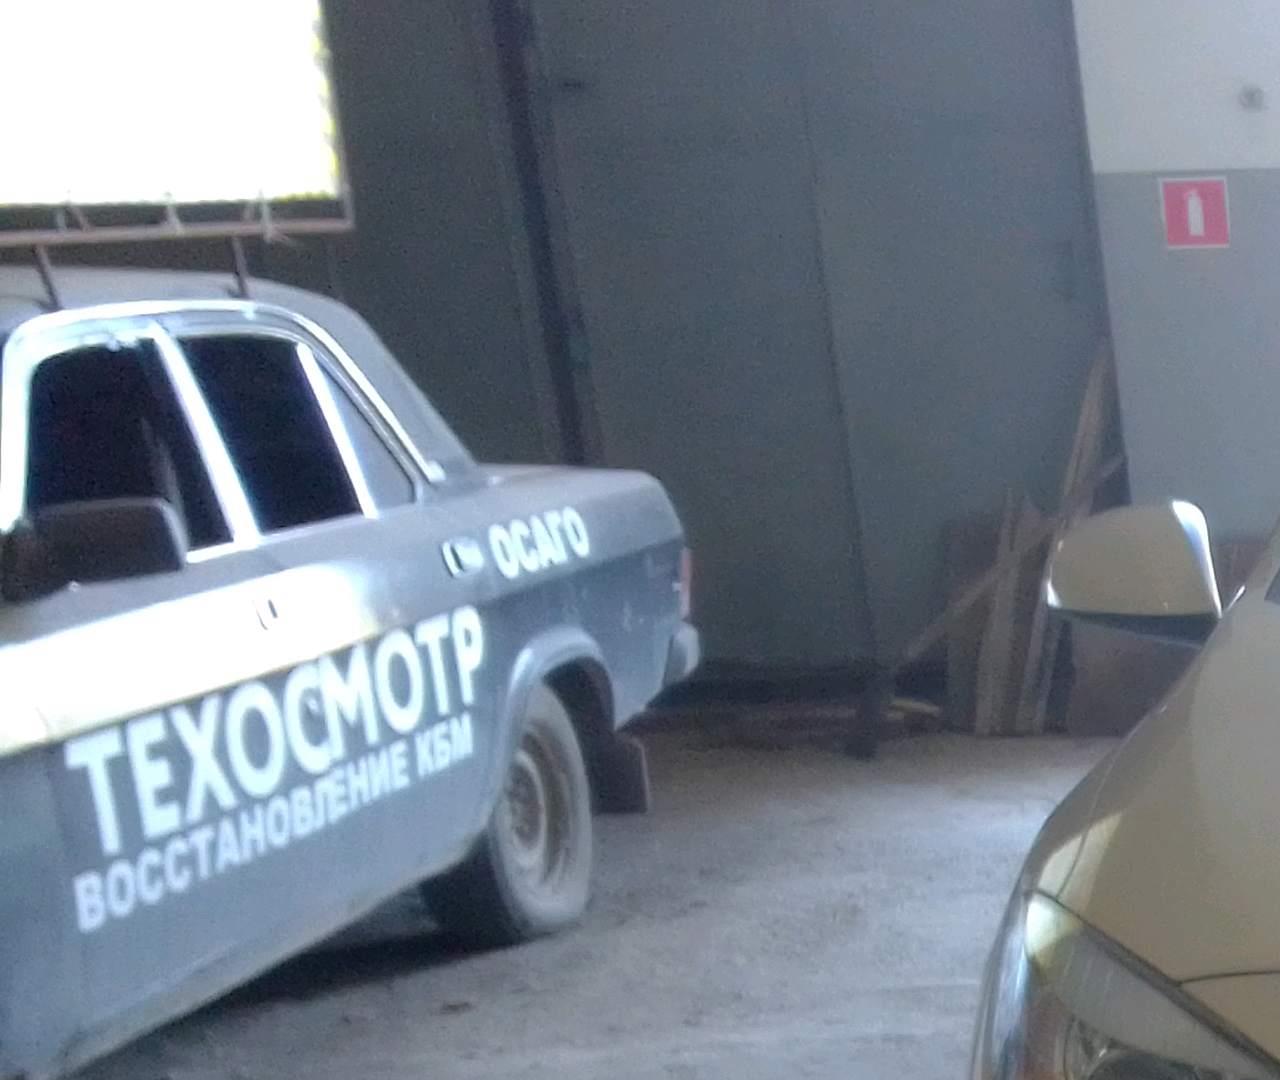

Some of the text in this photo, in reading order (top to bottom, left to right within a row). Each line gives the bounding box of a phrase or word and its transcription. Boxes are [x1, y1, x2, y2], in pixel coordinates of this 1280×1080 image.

[489, 506, 589, 579] ОСАГО
[64, 605, 483, 856] ТЕХОСМОТР
[72, 712, 475, 934] ВОССТАНОВЛЕНИЕ КБМ
